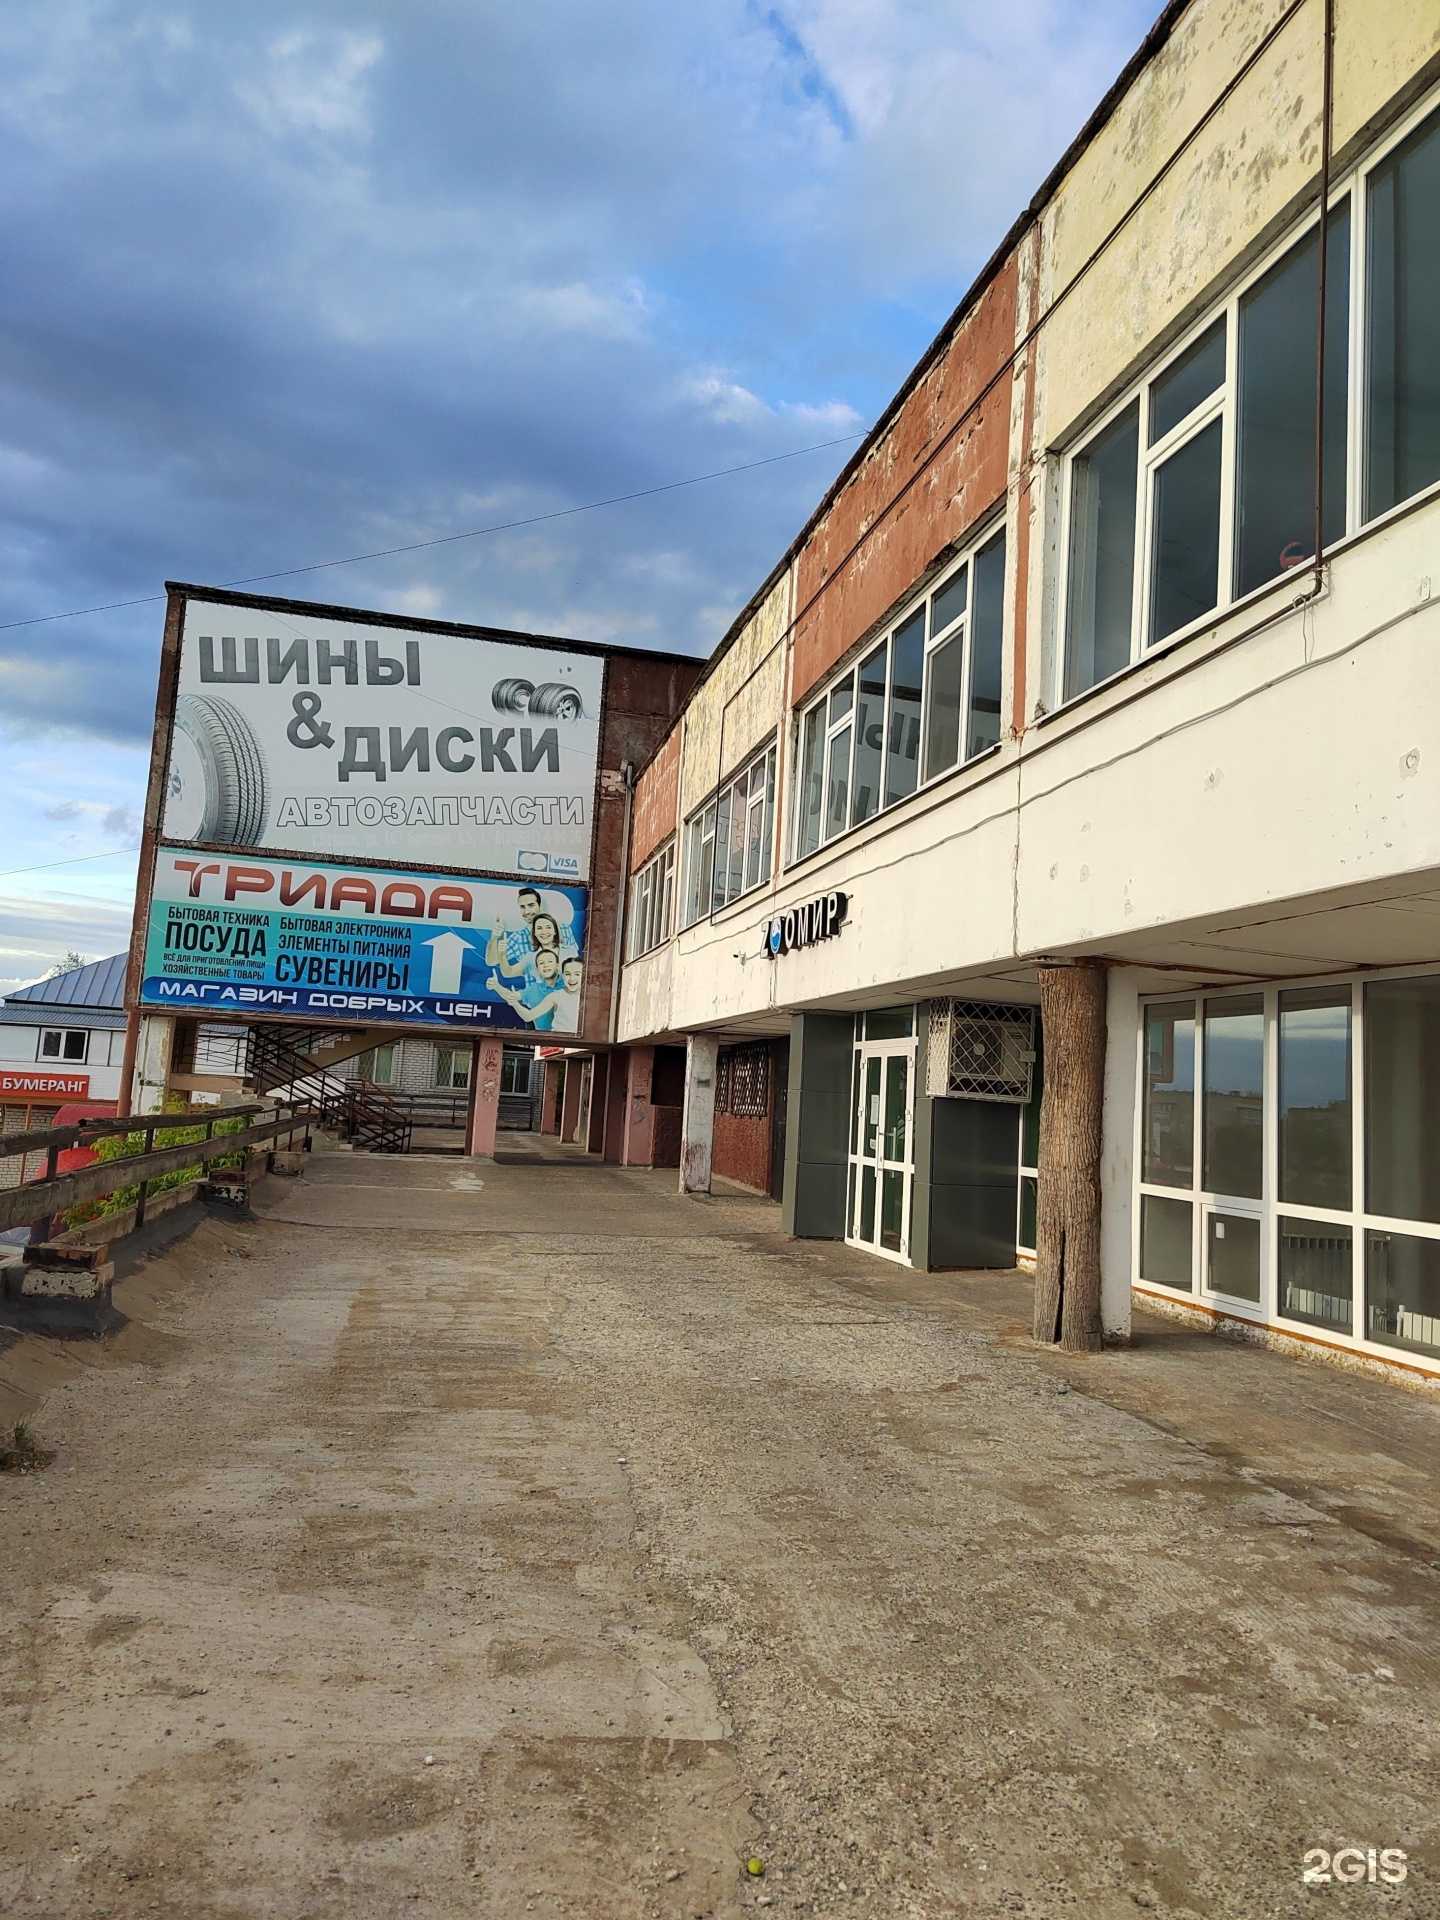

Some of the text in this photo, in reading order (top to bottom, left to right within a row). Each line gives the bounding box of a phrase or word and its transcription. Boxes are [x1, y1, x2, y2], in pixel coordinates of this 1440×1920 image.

[199, 637, 421, 686] ШИНЫ
[286, 690, 560, 783] & ДИСКИ
[276, 796, 585, 828] АВТОЗАПЧАСТИ
[553, 857, 579, 869] VISA
[174, 859, 473, 923] ТРИАДА
[168, 906, 270, 928] БЫТОВАЯ ТЕХНИКА
[280, 916, 412, 941] БЫТОВАЯ ЭЛЕКТРОНИКА
[164, 921, 267, 959] ПОСУДА
[278, 934, 411, 960] ЭЛЕМЕНТЫ ПИТАНИЯ
[162, 963, 265, 981] ХОЗЯЙСТВЕННЫЕ ТОВАРЫ
[177, 955, 191, 964] ДЛЯ
[191, 956, 246, 969] ПРИГОТОВЛЕНИЯ
[275, 954, 409, 992] СУВЕНИРЫ
[159, 981, 492, 1019] МАГАЗИН ДОБРЫХ ЦЕН
[2, 1077, 87, 1093] БУМЕРАНГ
